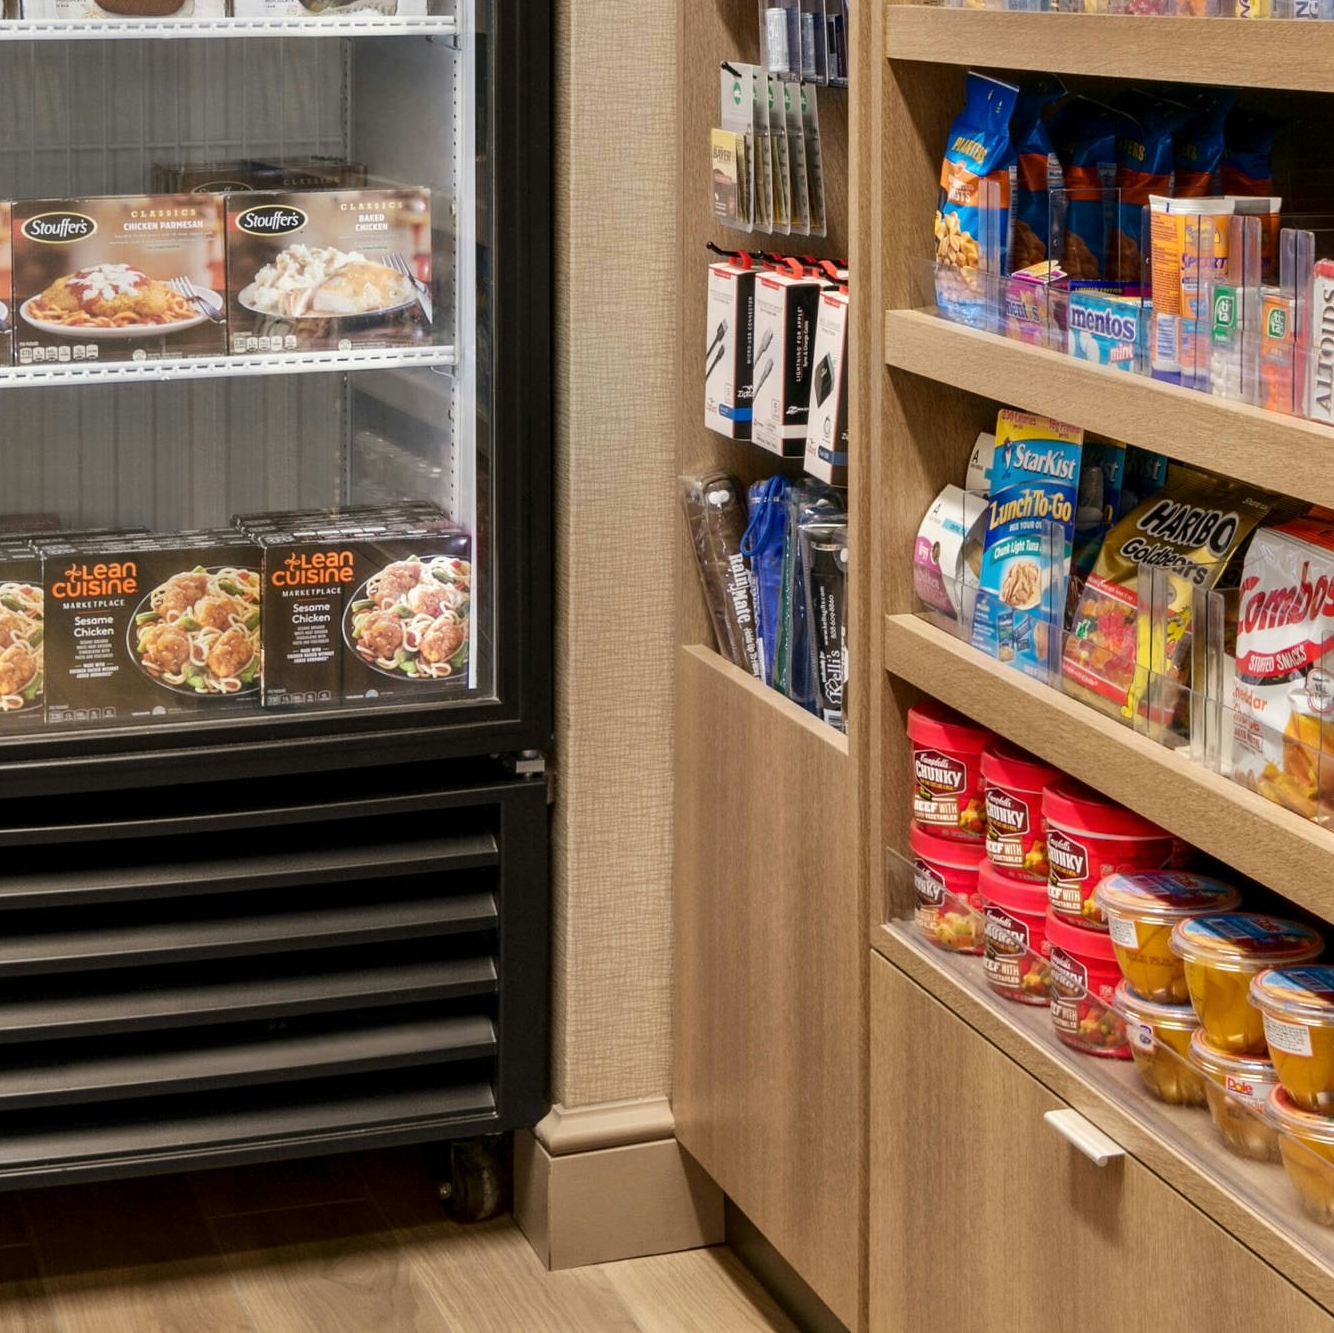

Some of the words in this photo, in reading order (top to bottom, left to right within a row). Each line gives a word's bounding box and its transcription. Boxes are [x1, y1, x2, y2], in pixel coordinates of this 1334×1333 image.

[340, 201, 404, 211] CLASSICS
[131, 208, 198, 218] CLASSICS
[358, 213, 385, 223] BAKED
[123, 220, 159, 230] CHICKEN
[160, 219, 204, 230] PARMESAN
[244, 210, 299, 230] Stouffer's
[30, 216, 88, 237] Stouffer's
[355, 222, 388, 232] CHICKEN
[1071, 304, 1136, 342] mentos
[1110, 345, 1135, 364] mint
[1013, 442, 1077, 480] StarKist
[989, 494, 1032, 530] Lunch
[1137, 500, 1239, 556] HARIBO
[994, 541, 1010, 559] Chunk
[1011, 540, 1025, 557] Light
[1025, 538, 1040, 553] Tuna
[282, 587, 342, 597] MARKETPLACE
[62, 599, 126, 610] MARKETPLACE
[292, 603, 331, 613] Sesame
[74, 615, 114, 626] Sesame
[291, 613, 331, 624] Chicken
[73, 626, 115, 637] Chicken
[915, 760, 963, 788] CHUNKY
[914, 799, 938, 812] BEEF
[939, 800, 958, 814] WITH
